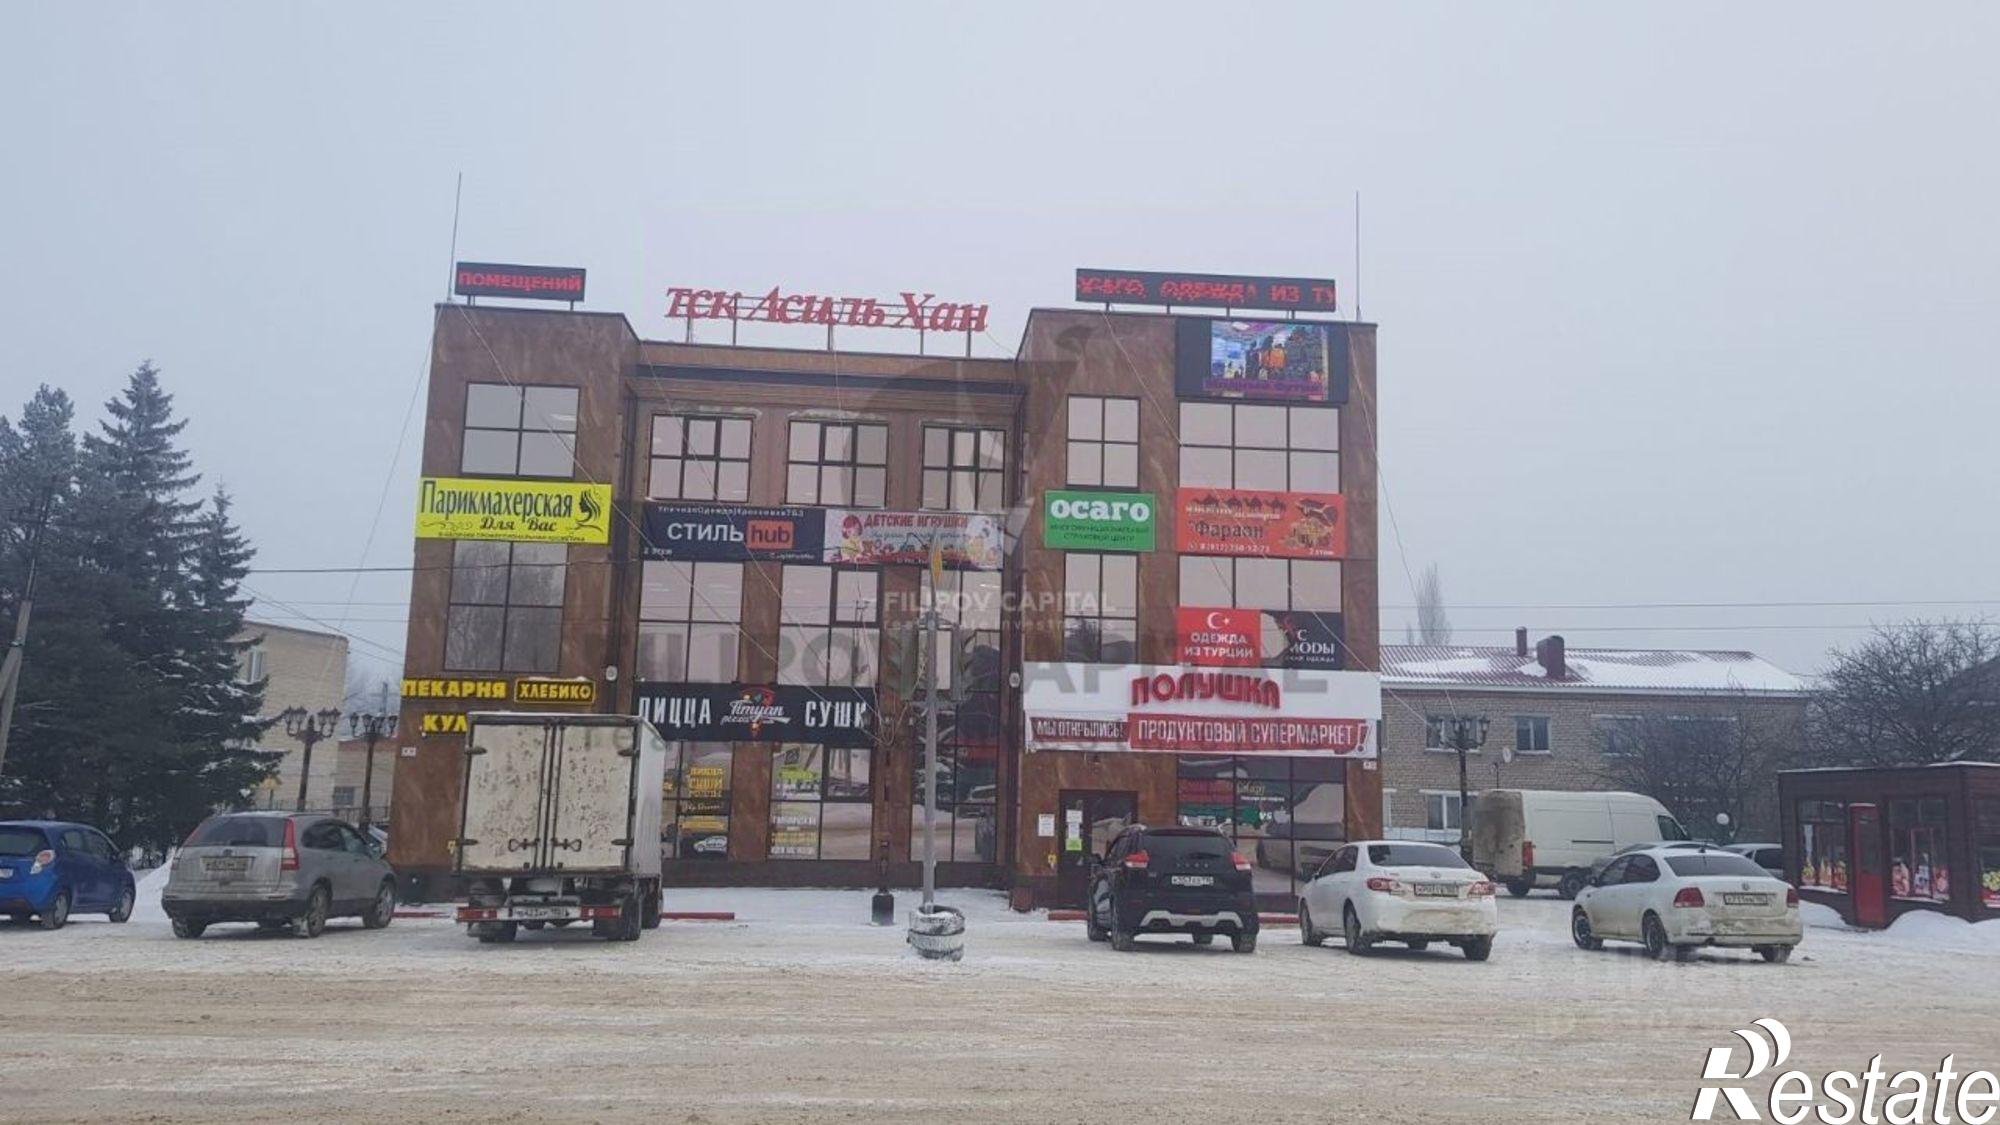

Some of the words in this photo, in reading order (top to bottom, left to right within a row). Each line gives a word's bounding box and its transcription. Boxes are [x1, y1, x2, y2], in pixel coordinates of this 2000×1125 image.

[459, 272, 581, 292] ПОМЕЩЕНИЙ
[1270, 285, 1300, 302] ИЗ
[748, 285, 885, 327] Асиль
[891, 292, 989, 332] Хан
[420, 480, 573, 522] Парикмахерская
[479, 517, 515, 531] Для
[526, 517, 557, 532] Вас
[864, 514, 914, 527] ДЕТСКИЕ
[917, 515, 968, 528] ИГРУШКИ
[667, 522, 744, 542] СТИЛЬ
[751, 526, 790, 543] hub
[1190, 632, 1248, 645] ОДЕЖДА
[1184, 646, 1201, 657] ИЗ
[1203, 647, 1254, 659] ТУРЦИИ
[401, 679, 507, 698] ПЕКАРНЯ
[519, 683, 592, 699] ХЛЕБИКО
[1130, 672, 1280, 709] ПОЛУШКА
[638, 696, 712, 729] ПИЦЦА
[729, 700, 785, 722] Timyan
[1037, 721, 1057, 736] МЫ
[1058, 721, 1124, 738] ОТКРЫЛИСЬ!
[1138, 719, 1247, 744] ПРОДУКТОВЫЙ
